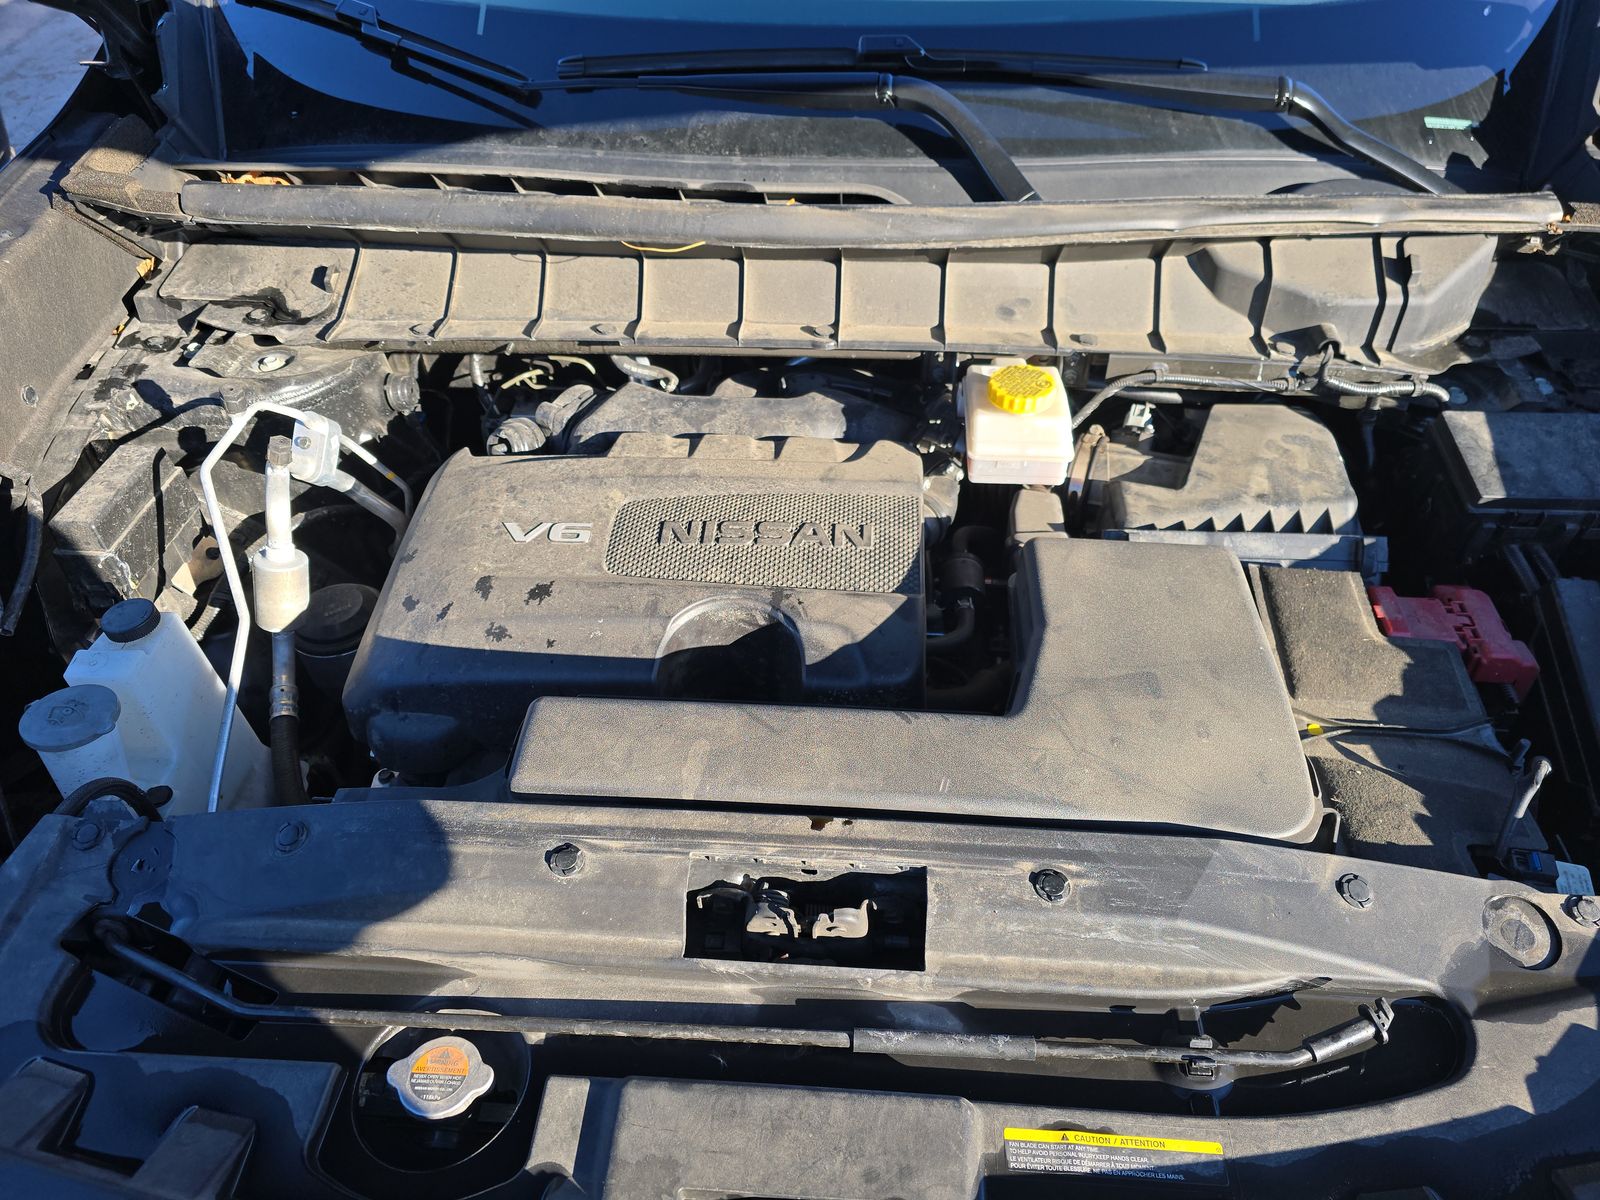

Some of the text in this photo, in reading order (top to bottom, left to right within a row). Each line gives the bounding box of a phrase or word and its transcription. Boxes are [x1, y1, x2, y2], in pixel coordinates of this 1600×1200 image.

[501, 521, 593, 543] V6
[659, 519, 874, 548] NISSAN
[1074, 1134, 1111, 1144] CAUTION
[1120, 1138, 1166, 1148] ATTENTION
[1026, 1162, 1044, 1170] ÉVITER
